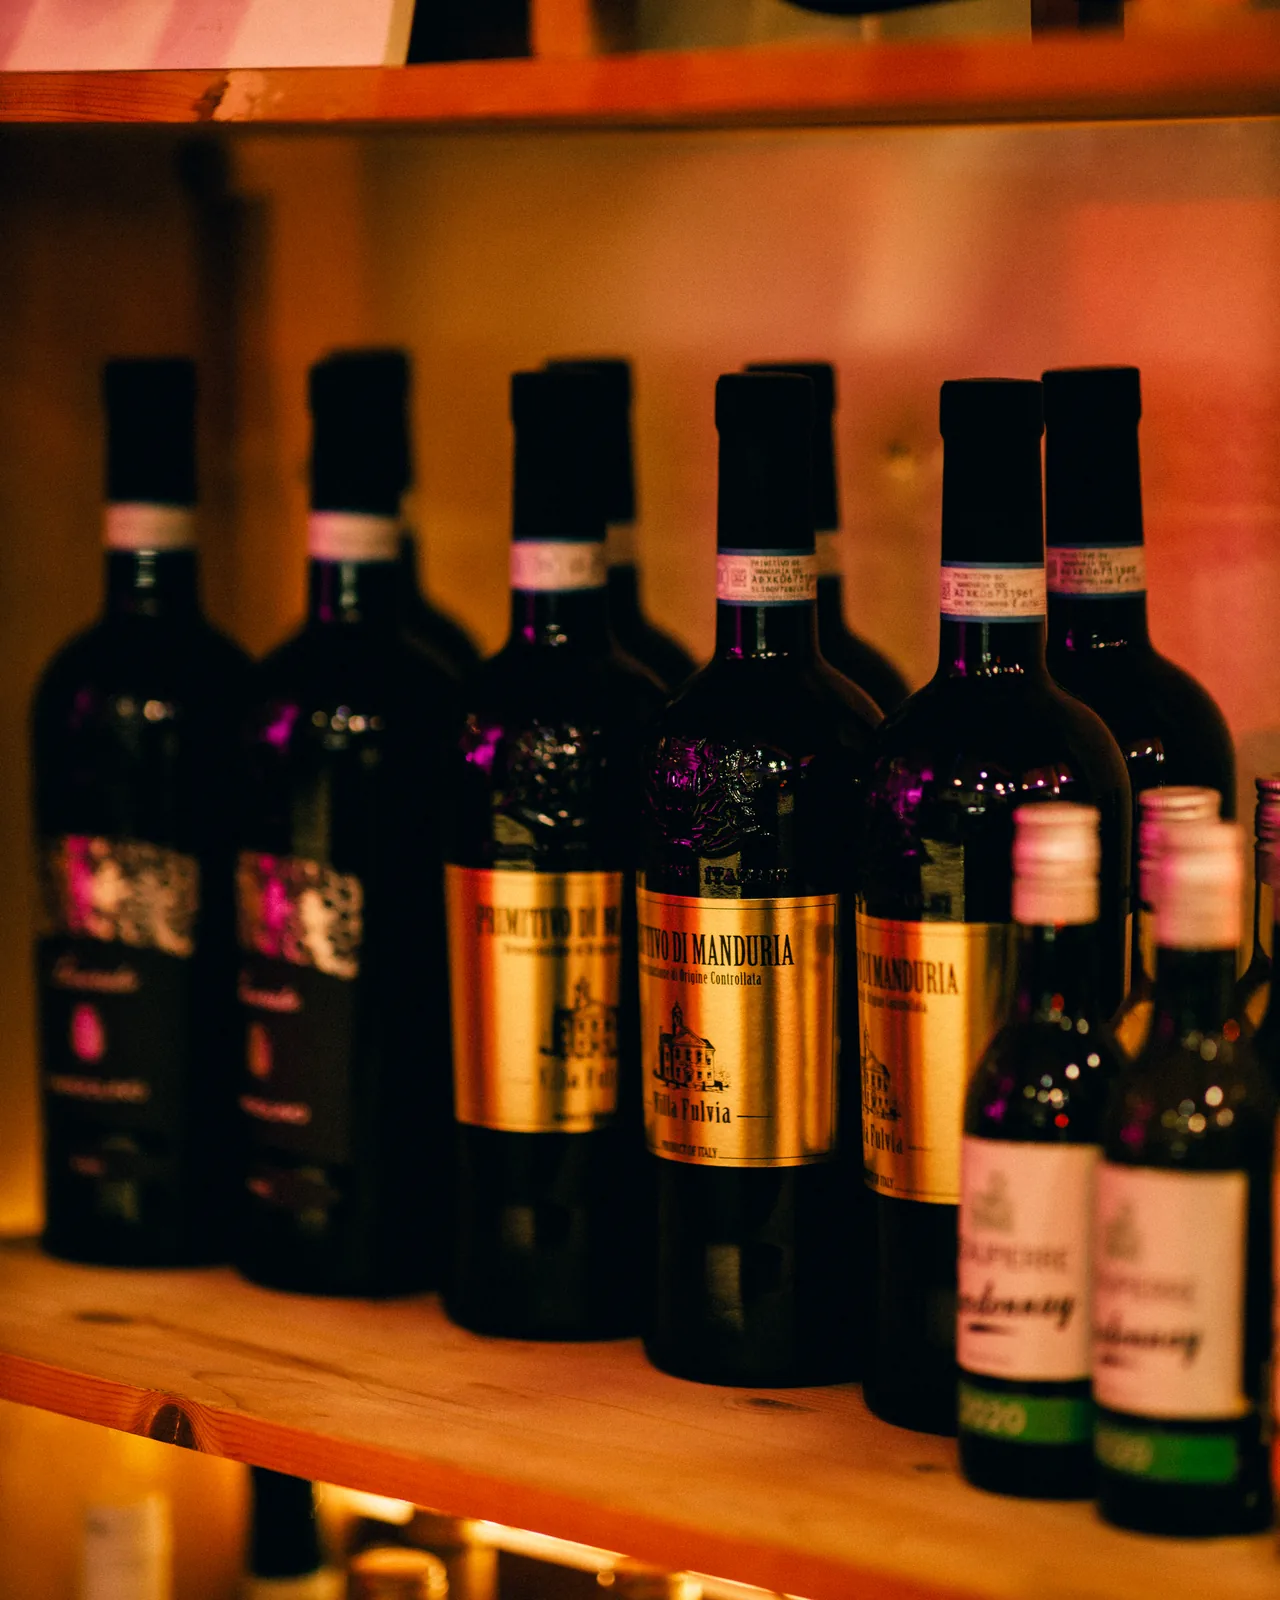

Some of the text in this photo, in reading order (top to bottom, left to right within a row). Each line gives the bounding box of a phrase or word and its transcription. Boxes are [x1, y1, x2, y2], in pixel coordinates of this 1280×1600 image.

[672, 931, 688, 964] DI
[692, 933, 795, 967] MANDURIA
[680, 969, 708, 985] Origine
[710, 971, 762, 986] Controllata
[873, 956, 959, 995] MANDURIA
[653, 1091, 731, 1123] Villa Fulvia
[871, 1123, 904, 1155] Fulvia
